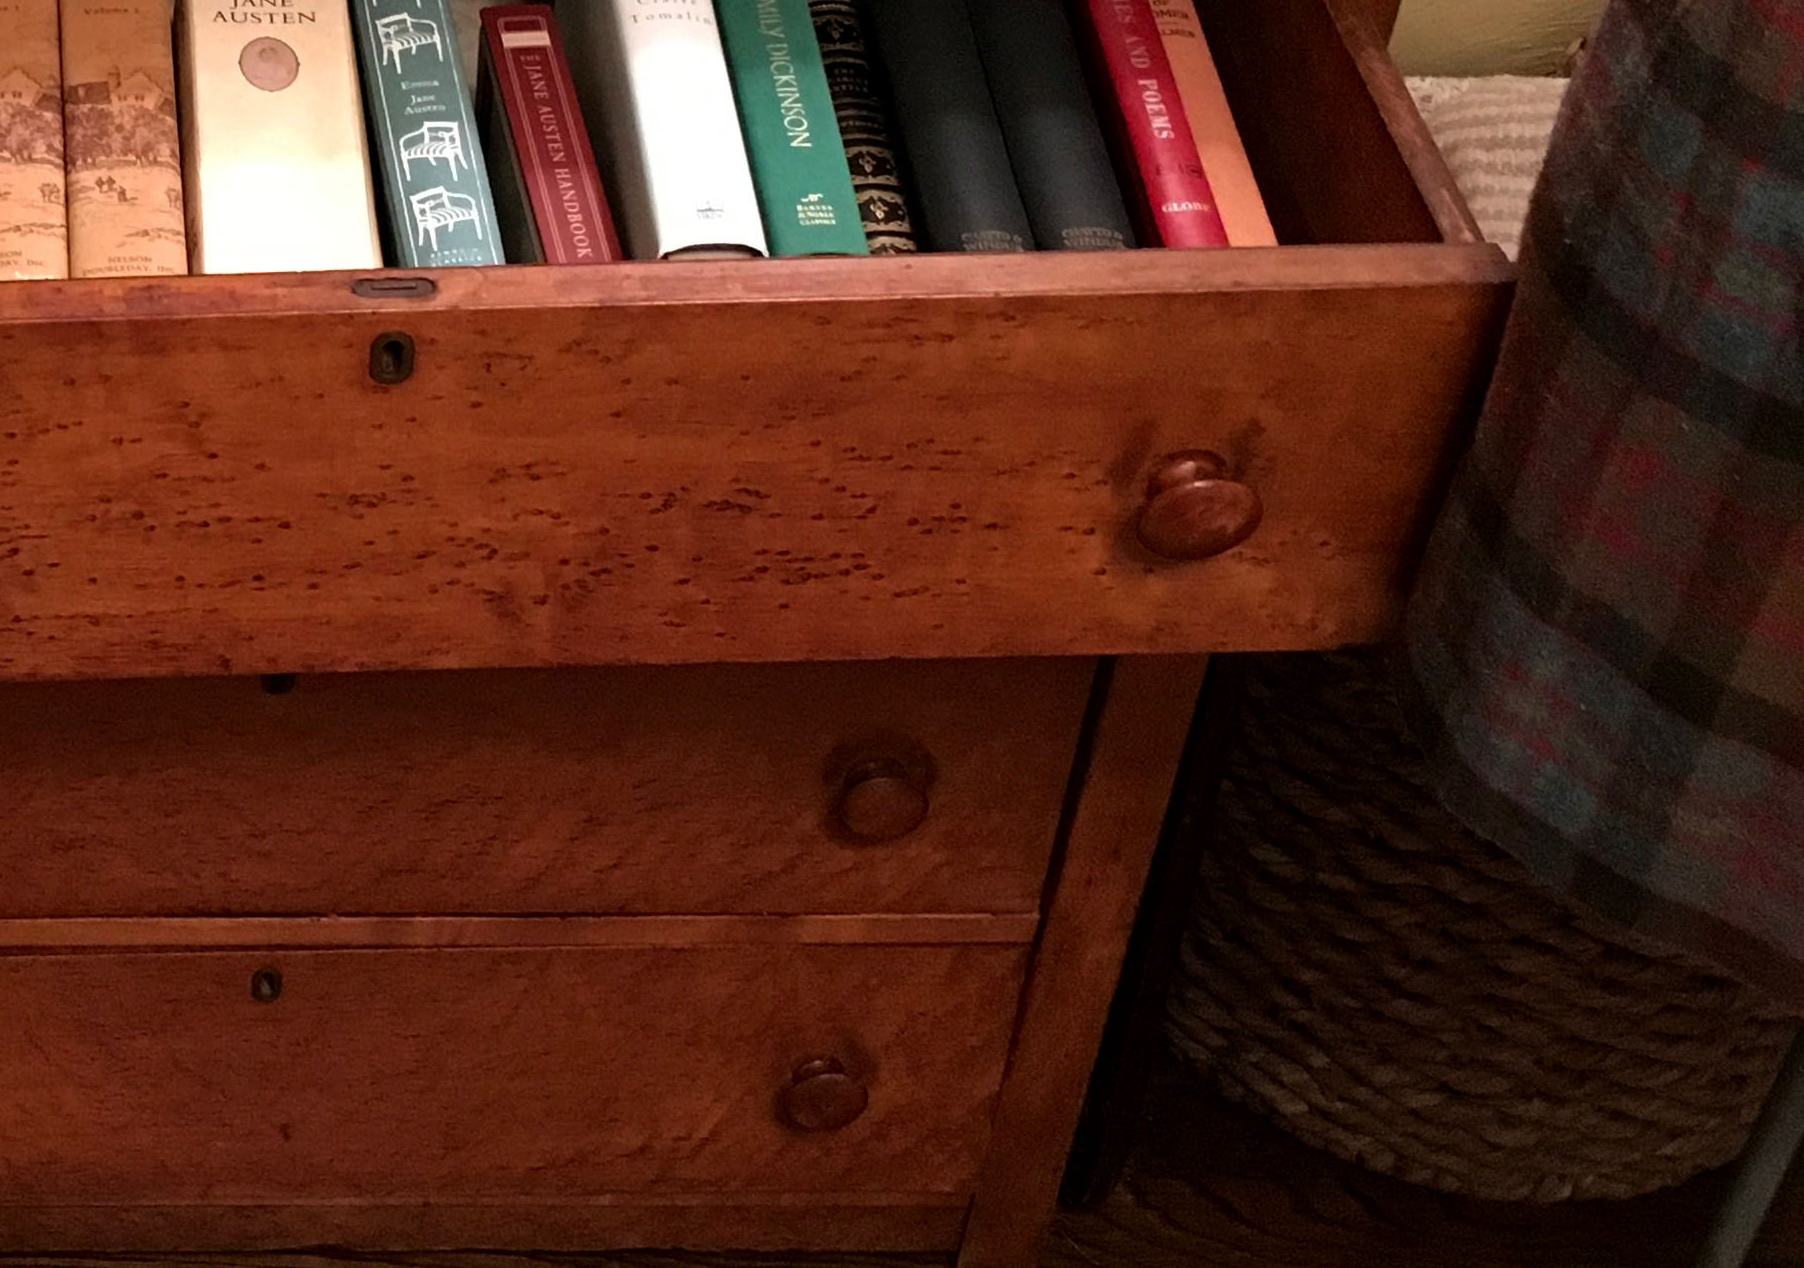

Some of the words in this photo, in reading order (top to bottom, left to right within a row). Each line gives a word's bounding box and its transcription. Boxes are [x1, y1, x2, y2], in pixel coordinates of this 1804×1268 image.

[84, 6, 128, 15] Volume
[213, 11, 316, 24] AUSTEN
[400, 80, 439, 90] Emma
[1124, 35, 1151, 69] AND
[1138, 79, 1175, 139] POEMS
[410, 95, 435, 106] Jane
[766, 43, 812, 148] DICKINSON
[404, 105, 446, 115] Austen
[524, 66, 549, 99] JANE
[539, 105, 566, 162] AUSTEN
[555, 168, 593, 259] HANDBOOK
[797, 204, 833, 212] BARNES
[1161, 201, 1211, 213] GLOBE
[108, 255, 152, 264] NELSON
